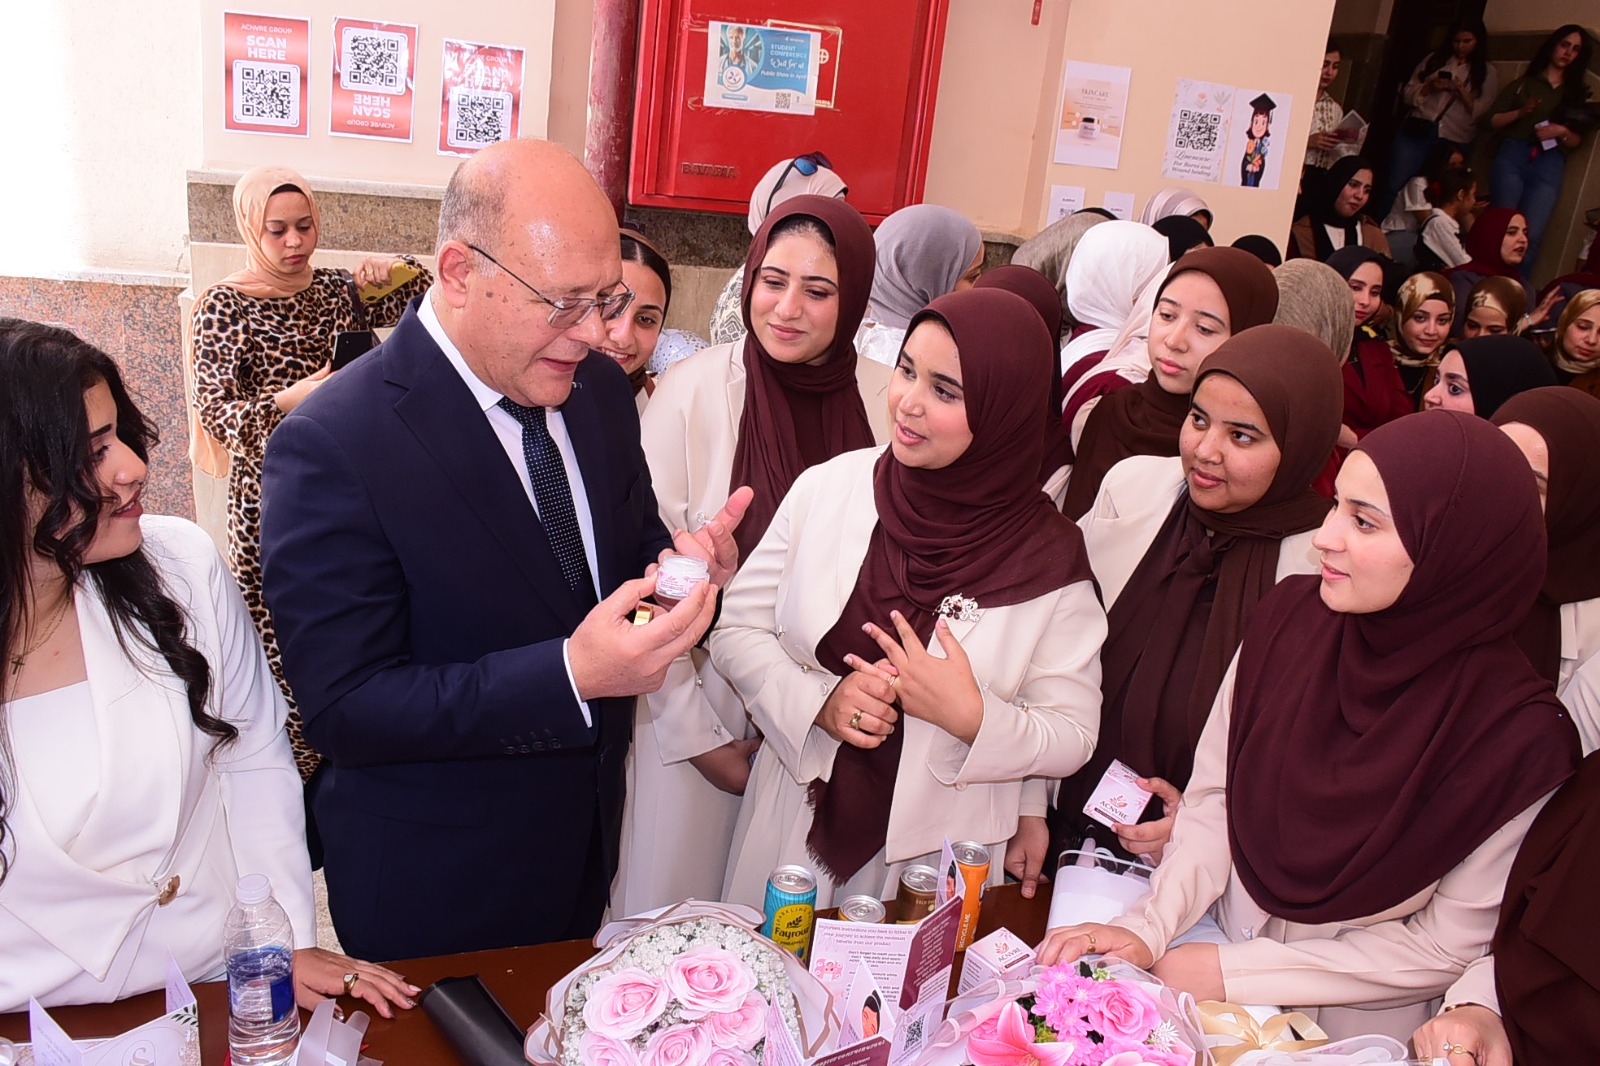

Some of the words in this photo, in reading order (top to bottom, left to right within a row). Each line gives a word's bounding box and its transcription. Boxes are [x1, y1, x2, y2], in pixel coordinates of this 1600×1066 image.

[268, 25, 292, 34] GROUP
[246, 34, 287, 49] SCAN
[770, 43, 797, 51] STUDENT
[247, 47, 287, 60] HERE
[769, 50, 807, 59] CONFERENCE
[786, 58, 797, 70] for
[353, 93, 391, 107] HERE
[352, 105, 391, 119] SCAN
[681, 161, 738, 178] BAVARIA
[1099, 800, 1129, 821] ACNVRE
[774, 926, 810, 940] Fayrouz
[958, 923, 969, 949] RECYCLE
